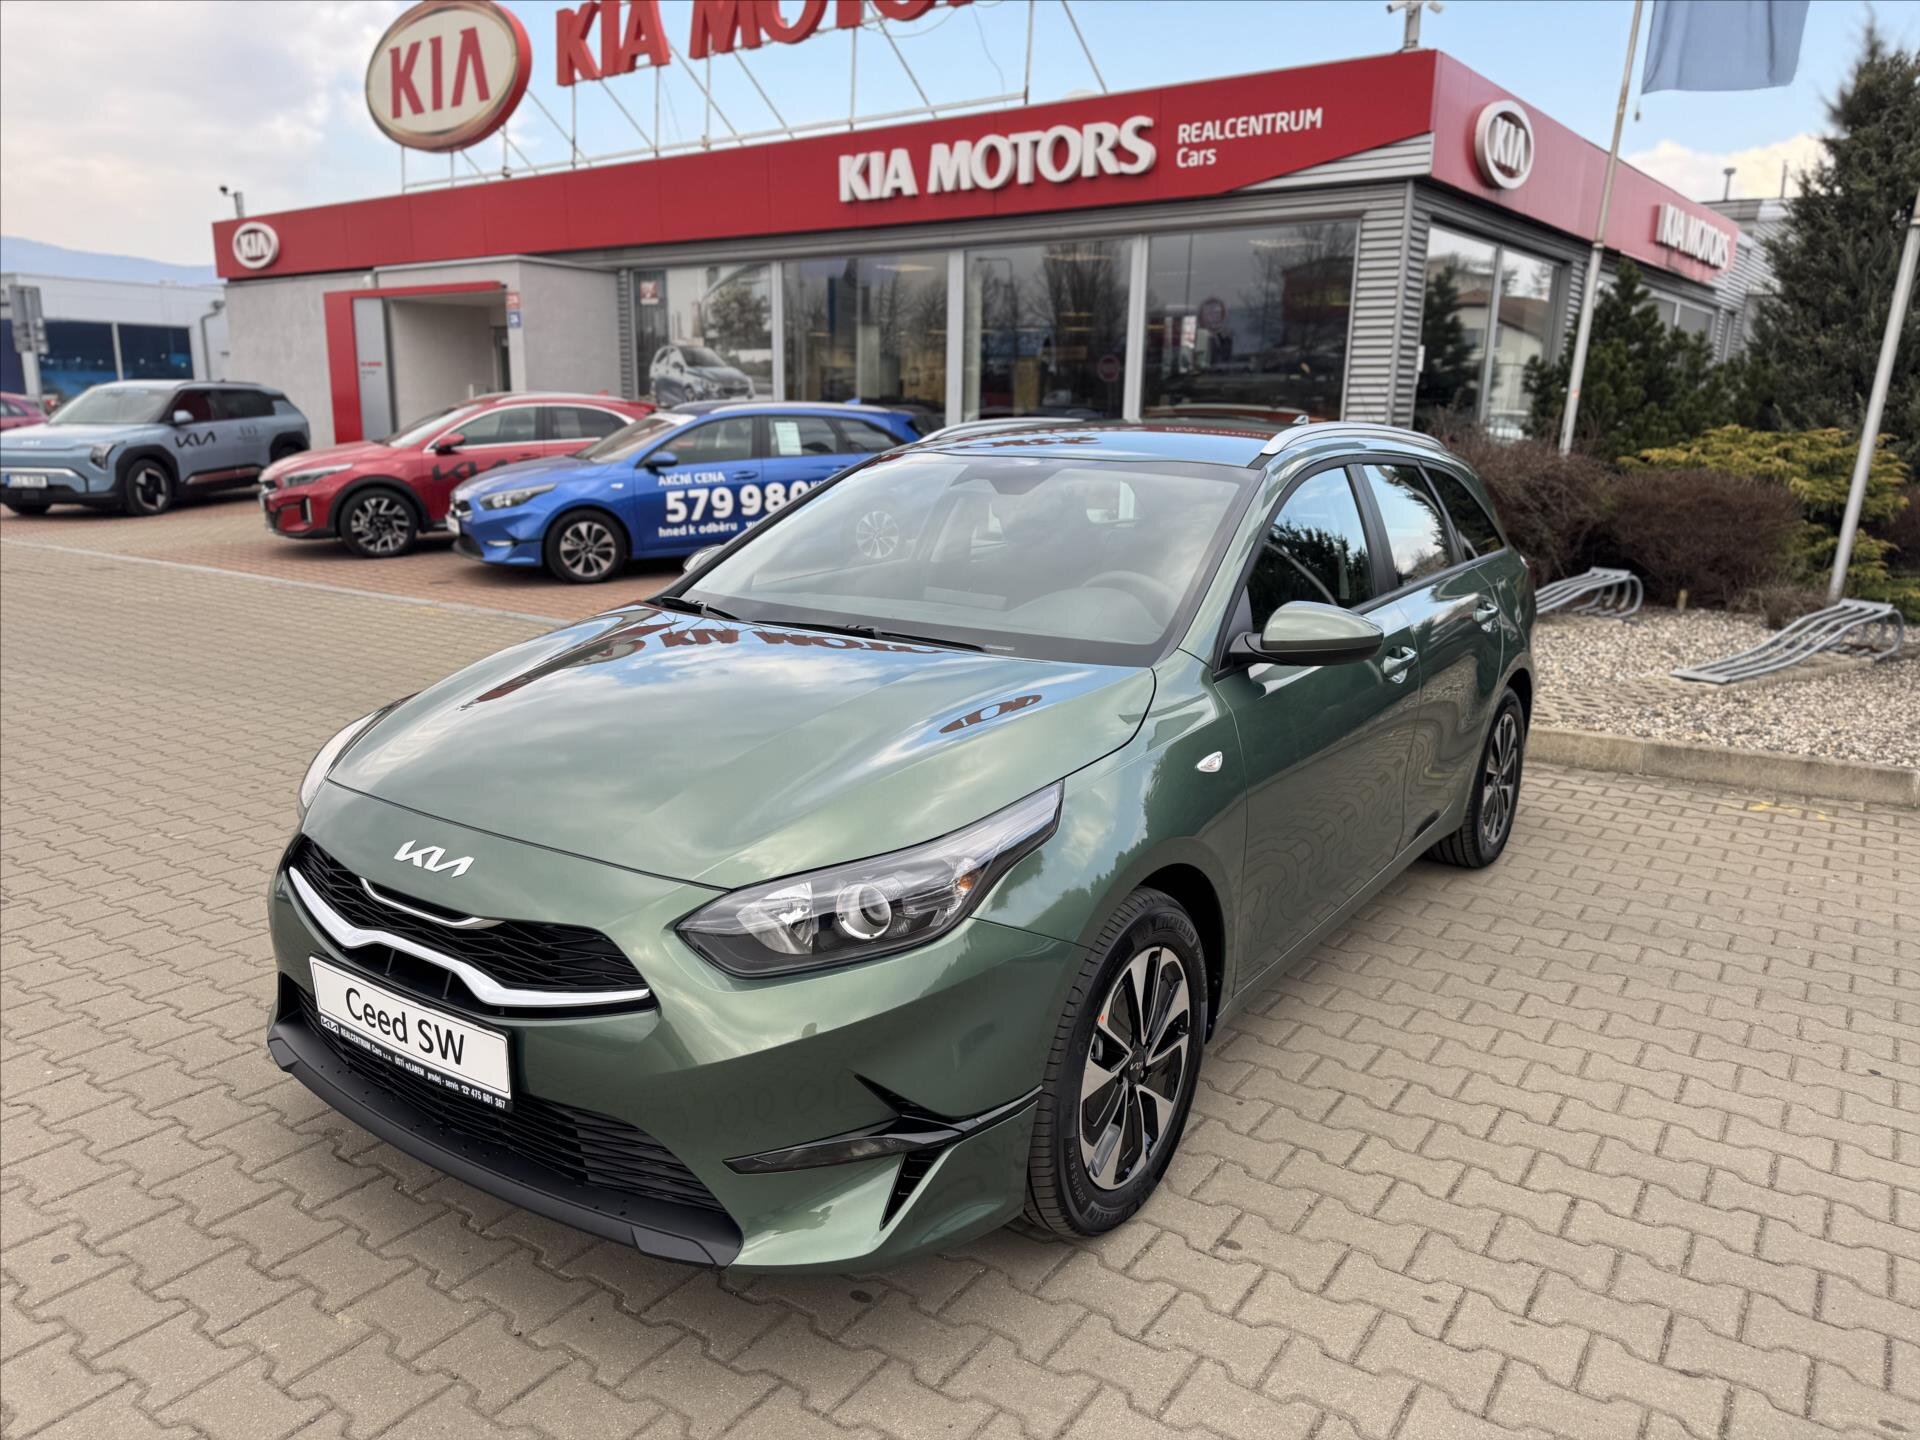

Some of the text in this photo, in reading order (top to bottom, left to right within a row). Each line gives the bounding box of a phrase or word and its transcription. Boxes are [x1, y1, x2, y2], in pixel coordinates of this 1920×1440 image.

[556, 0, 671, 87] KIA
[388, 26, 491, 119] KIA
[1177, 107, 1323, 144] REALCENTRUM
[1489, 115, 1527, 174] KIA
[839, 115, 1157, 203] KIA MOTORS
[1176, 147, 1217, 168] Cars
[239, 231, 271, 259] KIA
[1658, 203, 1732, 270] KIA MOTORS
[174, 430, 217, 448] KIA
[658, 471, 726, 487] AKČNÍ CENA
[666, 487, 734, 524] 579
[658, 525, 687, 538] hned
[688, 524, 697, 535] k
[698, 521, 738, 534] odběru
[393, 839, 475, 878] KIA
[345, 987, 465, 1066] Ceed SW
[340, 1027, 371, 1052] REALCENTRUM
[371, 1043, 382, 1057] Cars
[427, 1071, 442, 1085] prodej
[445, 1079, 459, 1091] servis
[470, 1088, 482, 1100] 475
